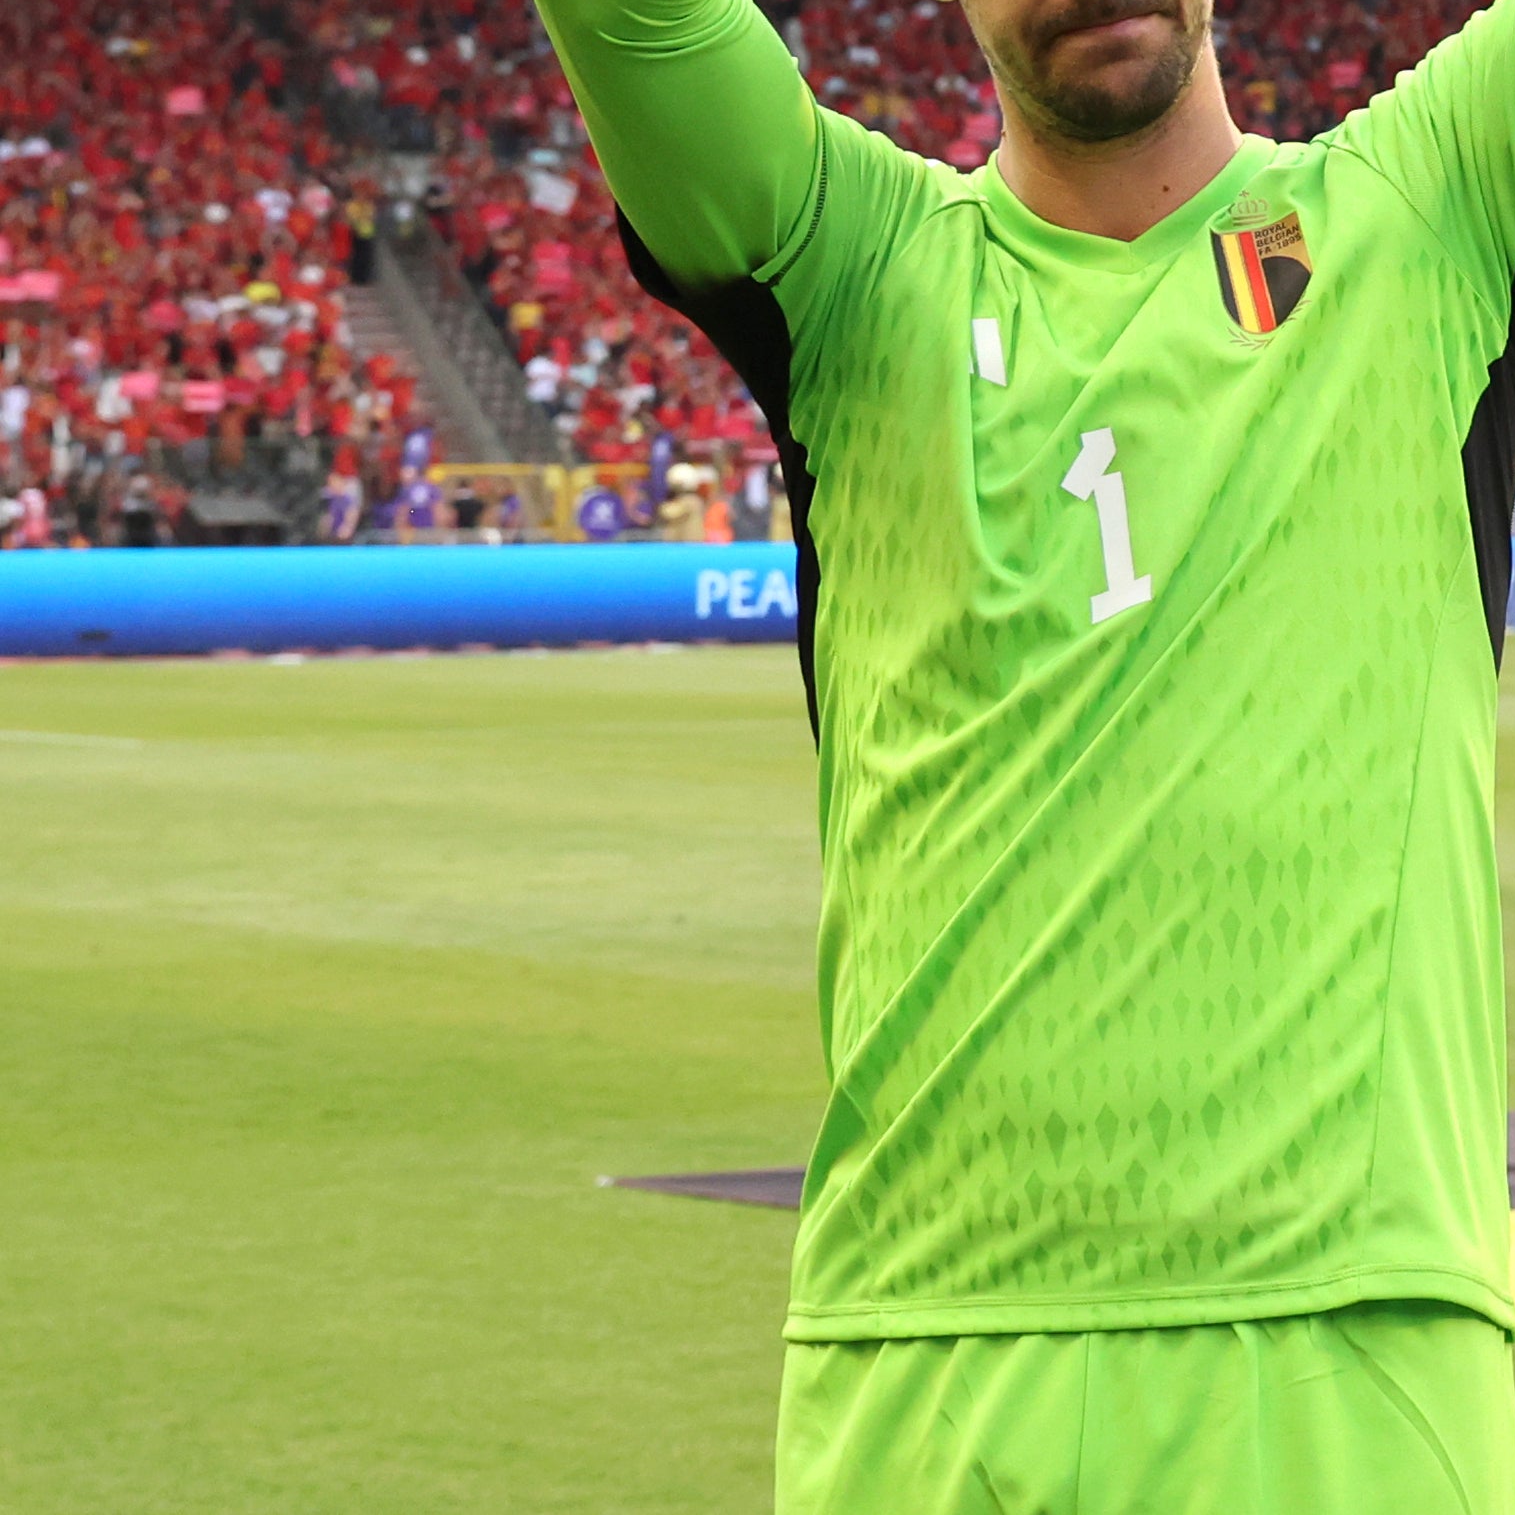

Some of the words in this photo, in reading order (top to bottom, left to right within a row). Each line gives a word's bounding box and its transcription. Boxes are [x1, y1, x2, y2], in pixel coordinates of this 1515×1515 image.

[1255, 222, 1286, 239] ROYAL
[1256, 224, 1300, 247] BELGIAN
[1258, 246, 1272, 256] FA
[1061, 427, 1152, 624] 1
[695, 568, 798, 619] PEA
